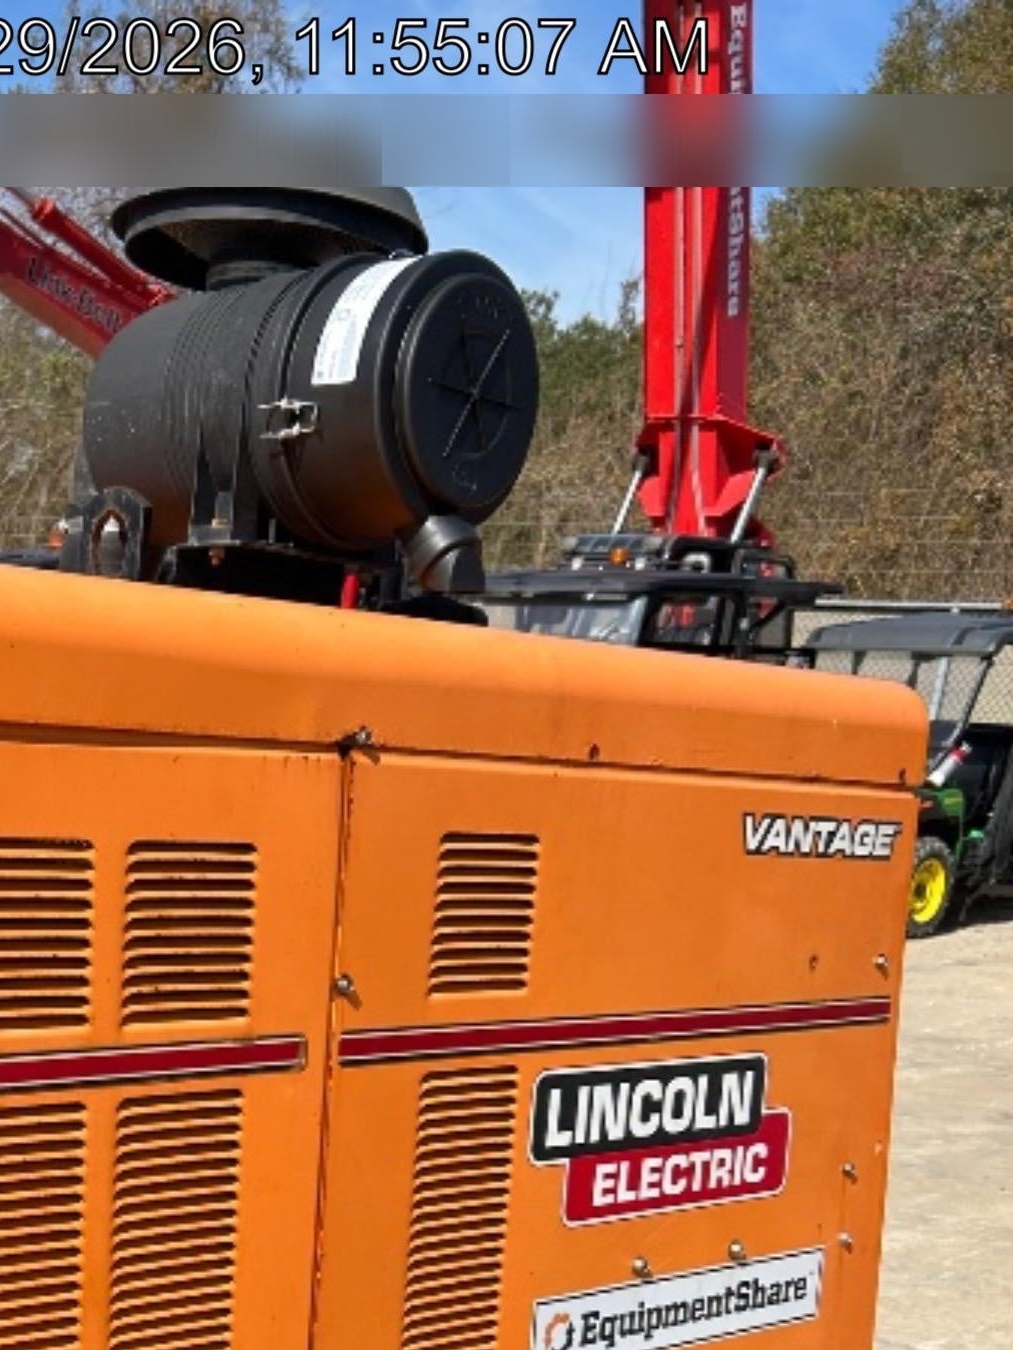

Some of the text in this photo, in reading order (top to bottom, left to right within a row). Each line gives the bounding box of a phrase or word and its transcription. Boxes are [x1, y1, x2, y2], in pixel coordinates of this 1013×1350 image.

[744, 813, 900, 859] VANTAGE
[545, 1070, 754, 1149] LINCOLN
[592, 1142, 768, 1207] ELECTRIC
[579, 1277, 808, 1348] EquipmentShare
